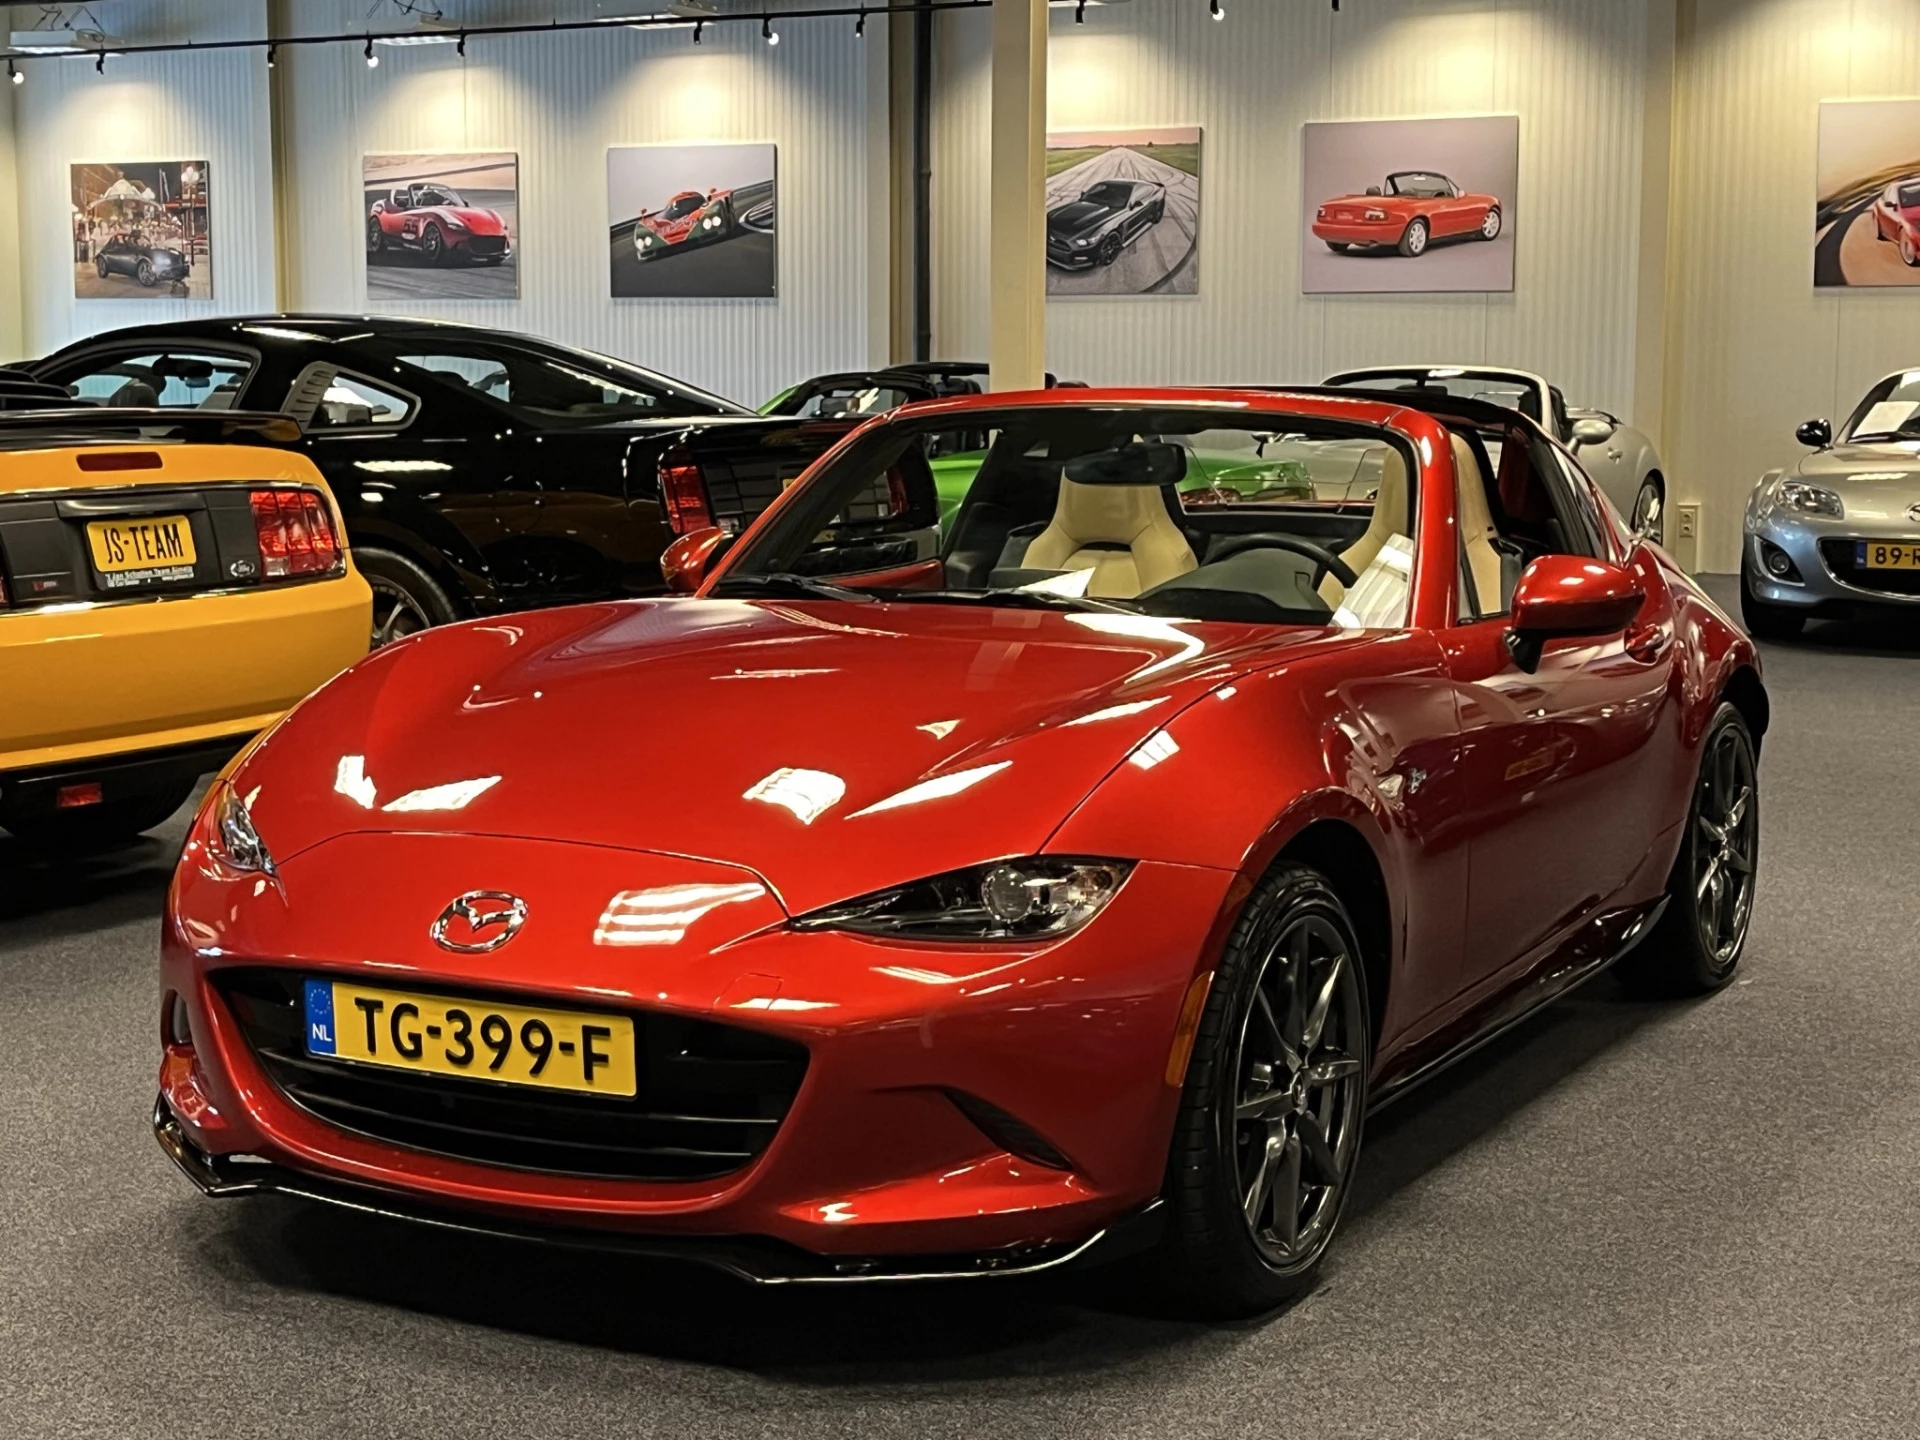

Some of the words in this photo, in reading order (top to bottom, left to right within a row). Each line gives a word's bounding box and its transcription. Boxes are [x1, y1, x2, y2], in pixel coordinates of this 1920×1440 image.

[103, 523, 184, 564] JS-TEAM
[312, 1023, 332, 1042] NL
[354, 997, 611, 1081] TG-399-F
